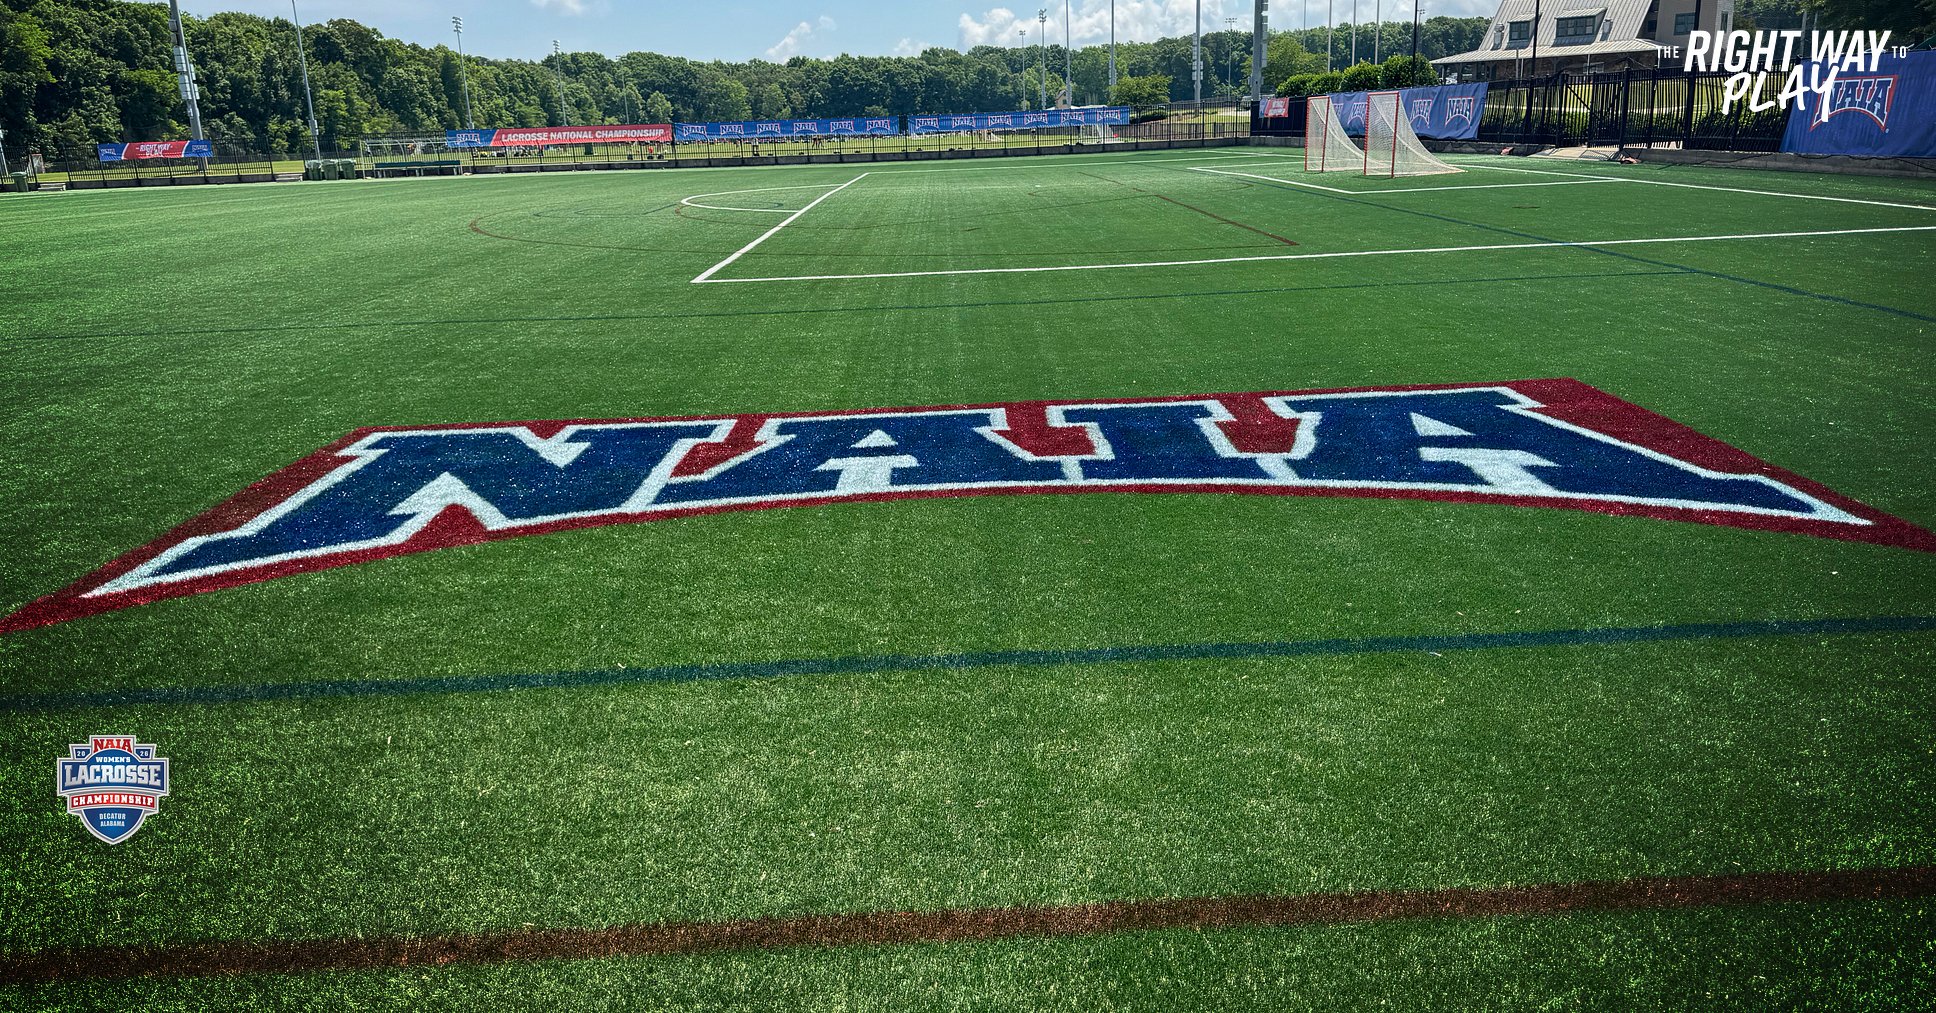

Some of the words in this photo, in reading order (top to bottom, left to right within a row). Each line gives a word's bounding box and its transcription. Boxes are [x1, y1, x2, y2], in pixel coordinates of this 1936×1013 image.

[1446, 97, 1474, 126] NAIA
[1811, 77, 1894, 127] NAIA
[502, 132, 548, 142] LACROSSE
[550, 130, 593, 140] NATIONAL
[595, 129, 664, 138] CHAMPIONSHIP
[757, 123, 781, 134] NAIA
[794, 122, 817, 132] NAIA
[82, 385, 1875, 598] NAIA
